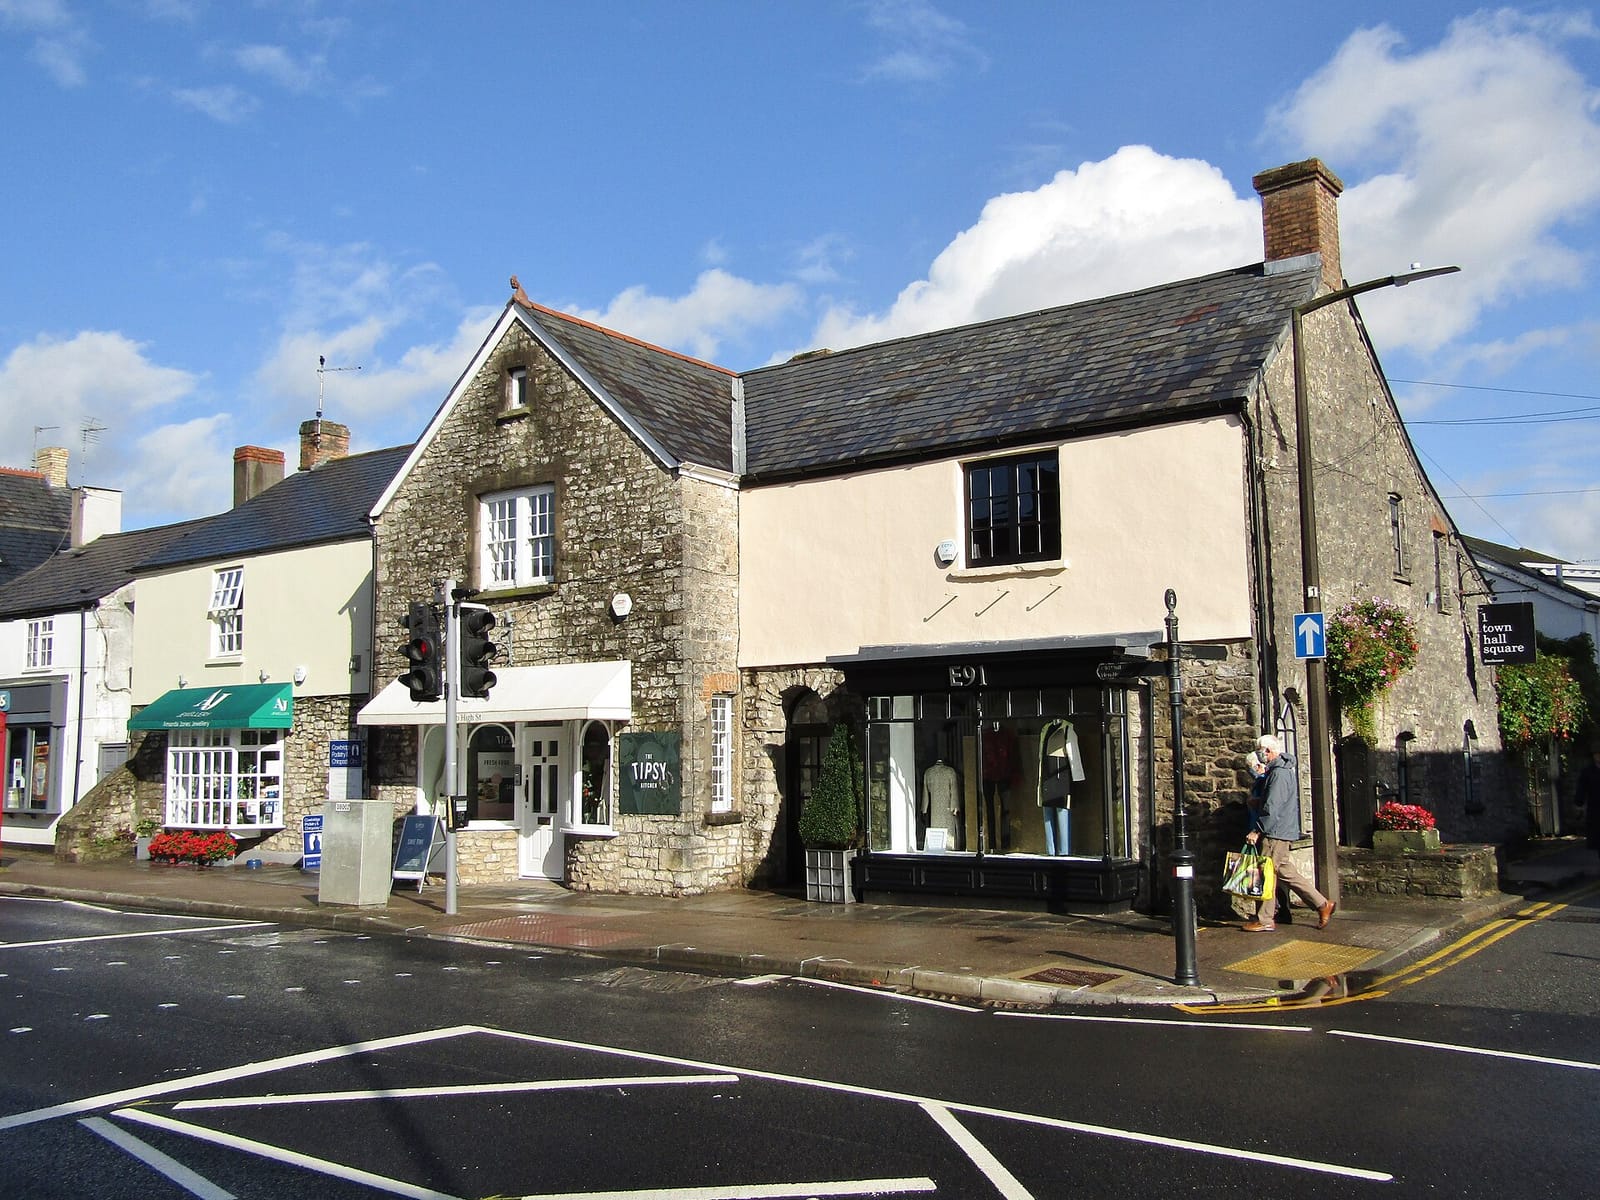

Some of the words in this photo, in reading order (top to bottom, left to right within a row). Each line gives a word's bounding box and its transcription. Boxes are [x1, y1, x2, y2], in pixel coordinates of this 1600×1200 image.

[1482, 613, 1488, 622] 1
[1482, 624, 1512, 633] town
[1483, 634, 1507, 645] hall
[1483, 645, 1525, 656] square
[949, 665, 988, 687] E91
[460, 713, 474, 722] High
[631, 761, 667, 781] TIPSY
